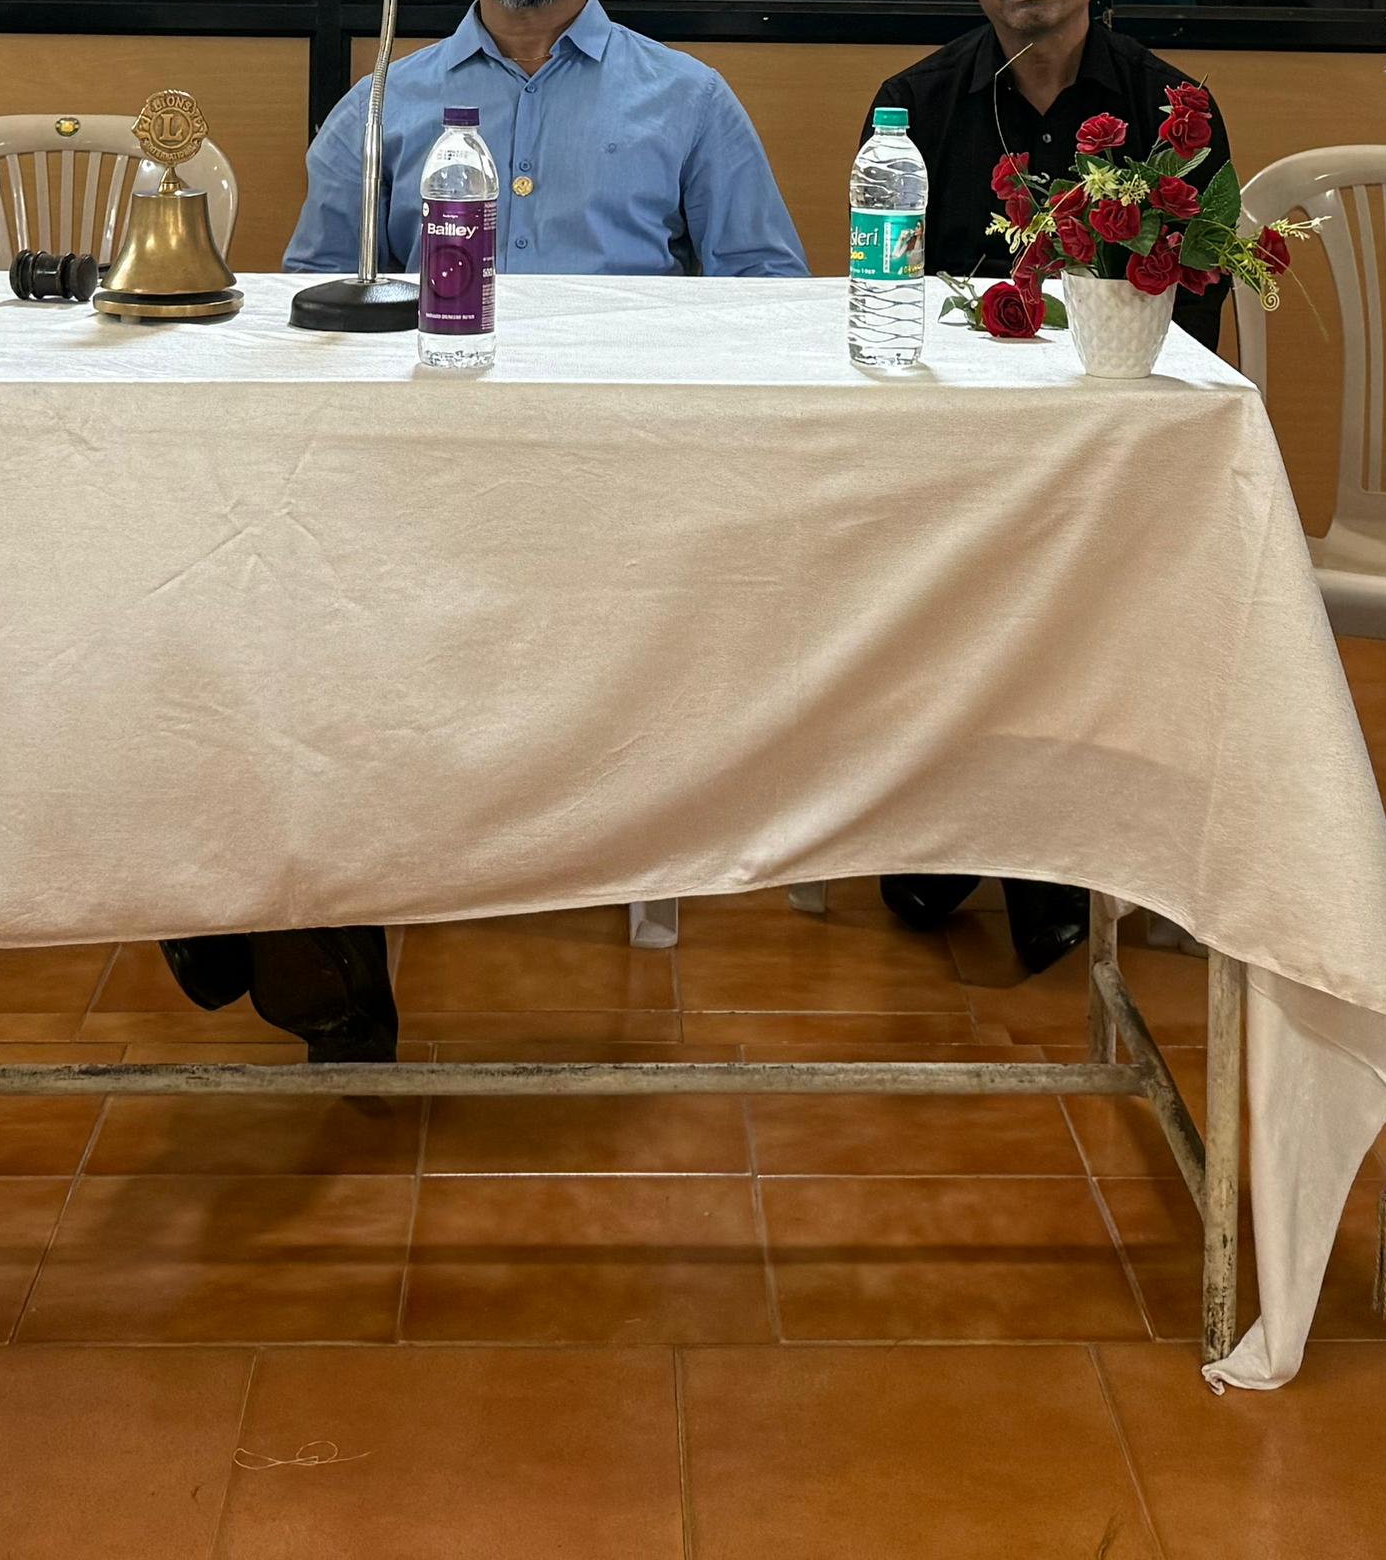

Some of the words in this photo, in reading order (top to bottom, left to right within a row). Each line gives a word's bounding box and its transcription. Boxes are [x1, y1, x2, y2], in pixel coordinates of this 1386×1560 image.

[153, 96, 193, 111] LIONS
[158, 113, 184, 141] L
[428, 222, 477, 239] Bailley
